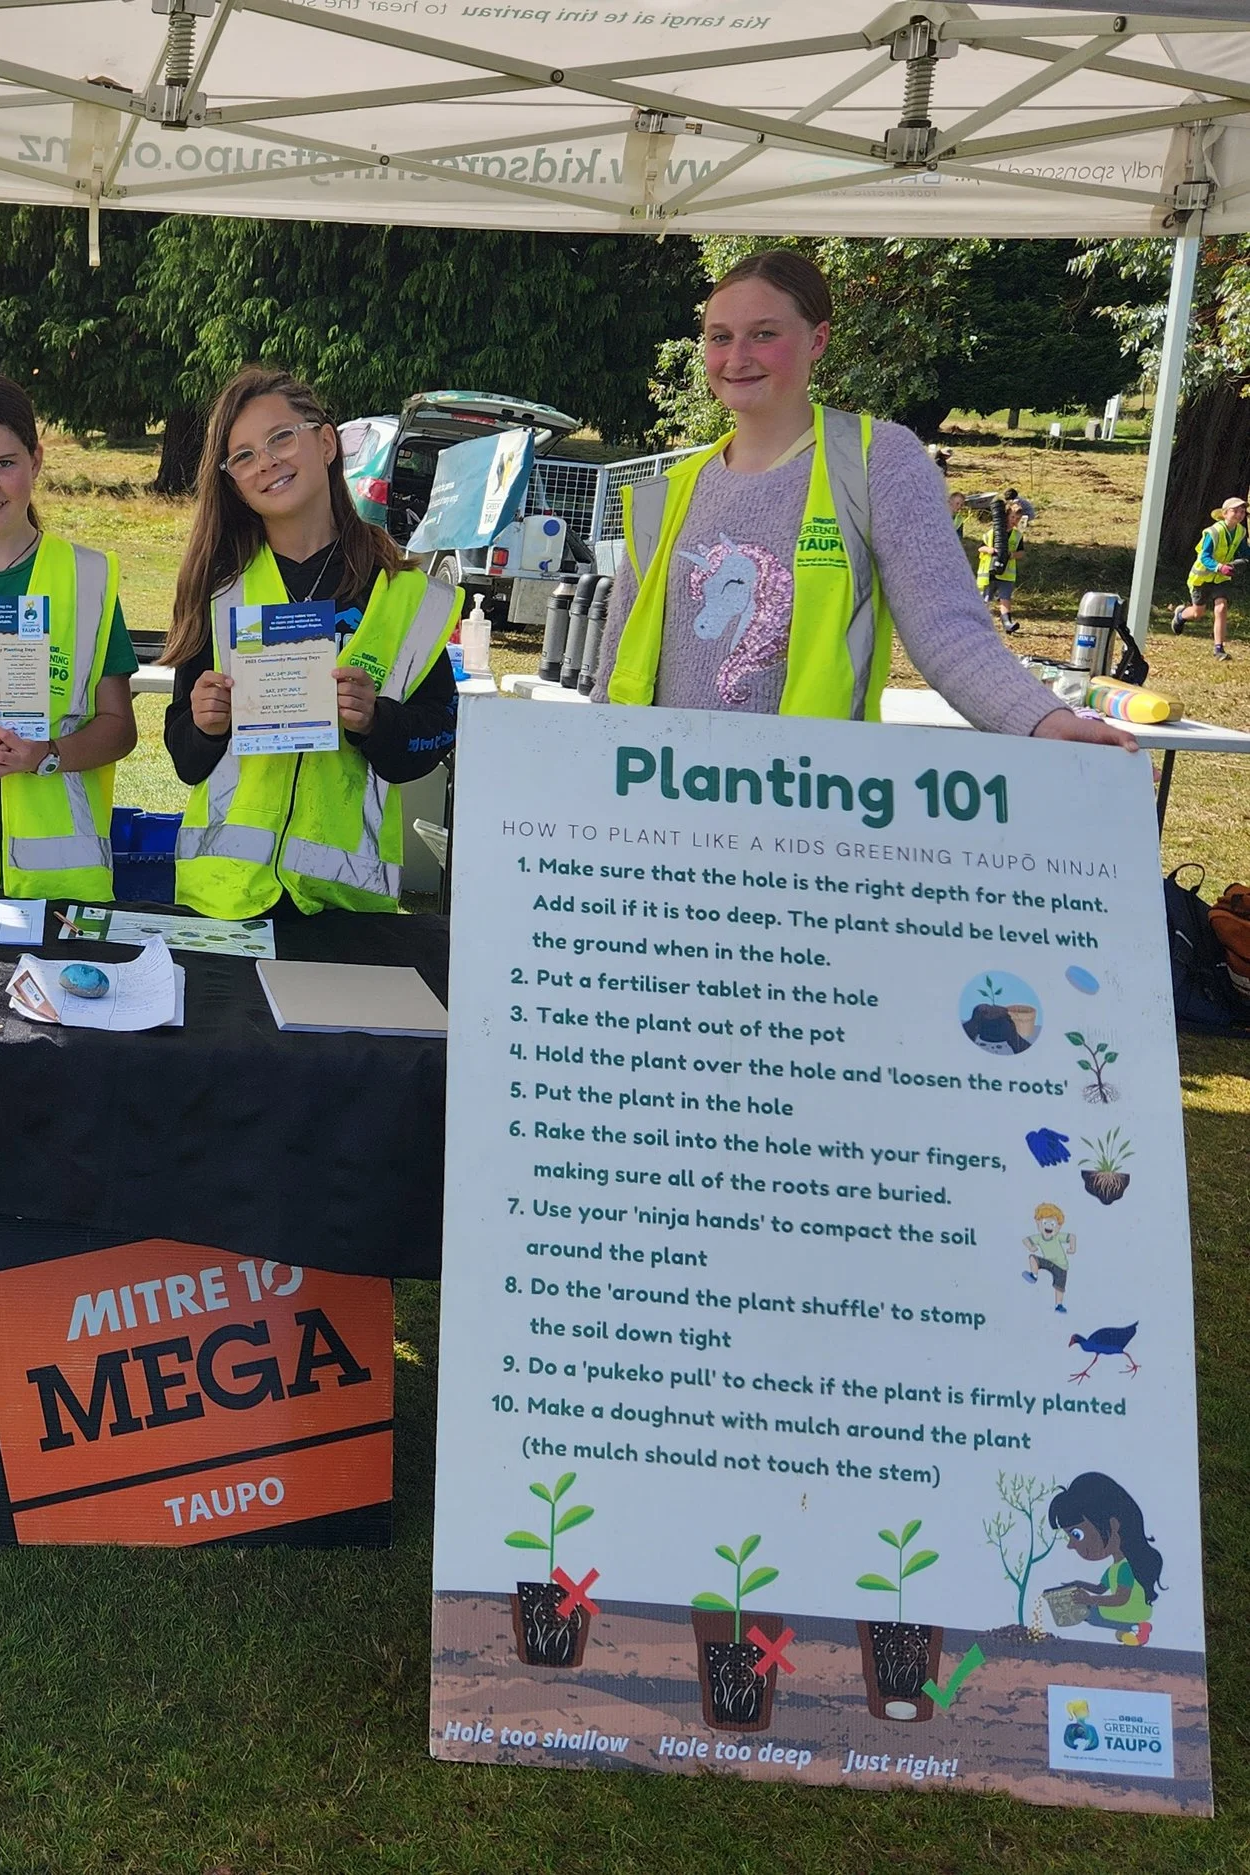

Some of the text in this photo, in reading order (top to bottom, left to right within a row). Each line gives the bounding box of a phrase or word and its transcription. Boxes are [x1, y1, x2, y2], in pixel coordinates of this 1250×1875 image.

[615, 745, 1008, 828] Planting 101
[503, 820, 1116, 879] HOW TO PLANT LIKE A KIDS GREENING TAUPŌ NINJA!
[518, 856, 1108, 913] 1. Make sure that the hole is the right depth for the plant.
[66, 1260, 304, 1341] MITRE 10
[26, 1308, 372, 1452] MEGA
[164, 1476, 286, 1527] TAUPO
[443, 1719, 629, 1754] Hole too shallow
[659, 1734, 813, 1772] Hole too deep
[1104, 1722, 1160, 1735] GREENING
[842, 1748, 958, 1781] Just right!
